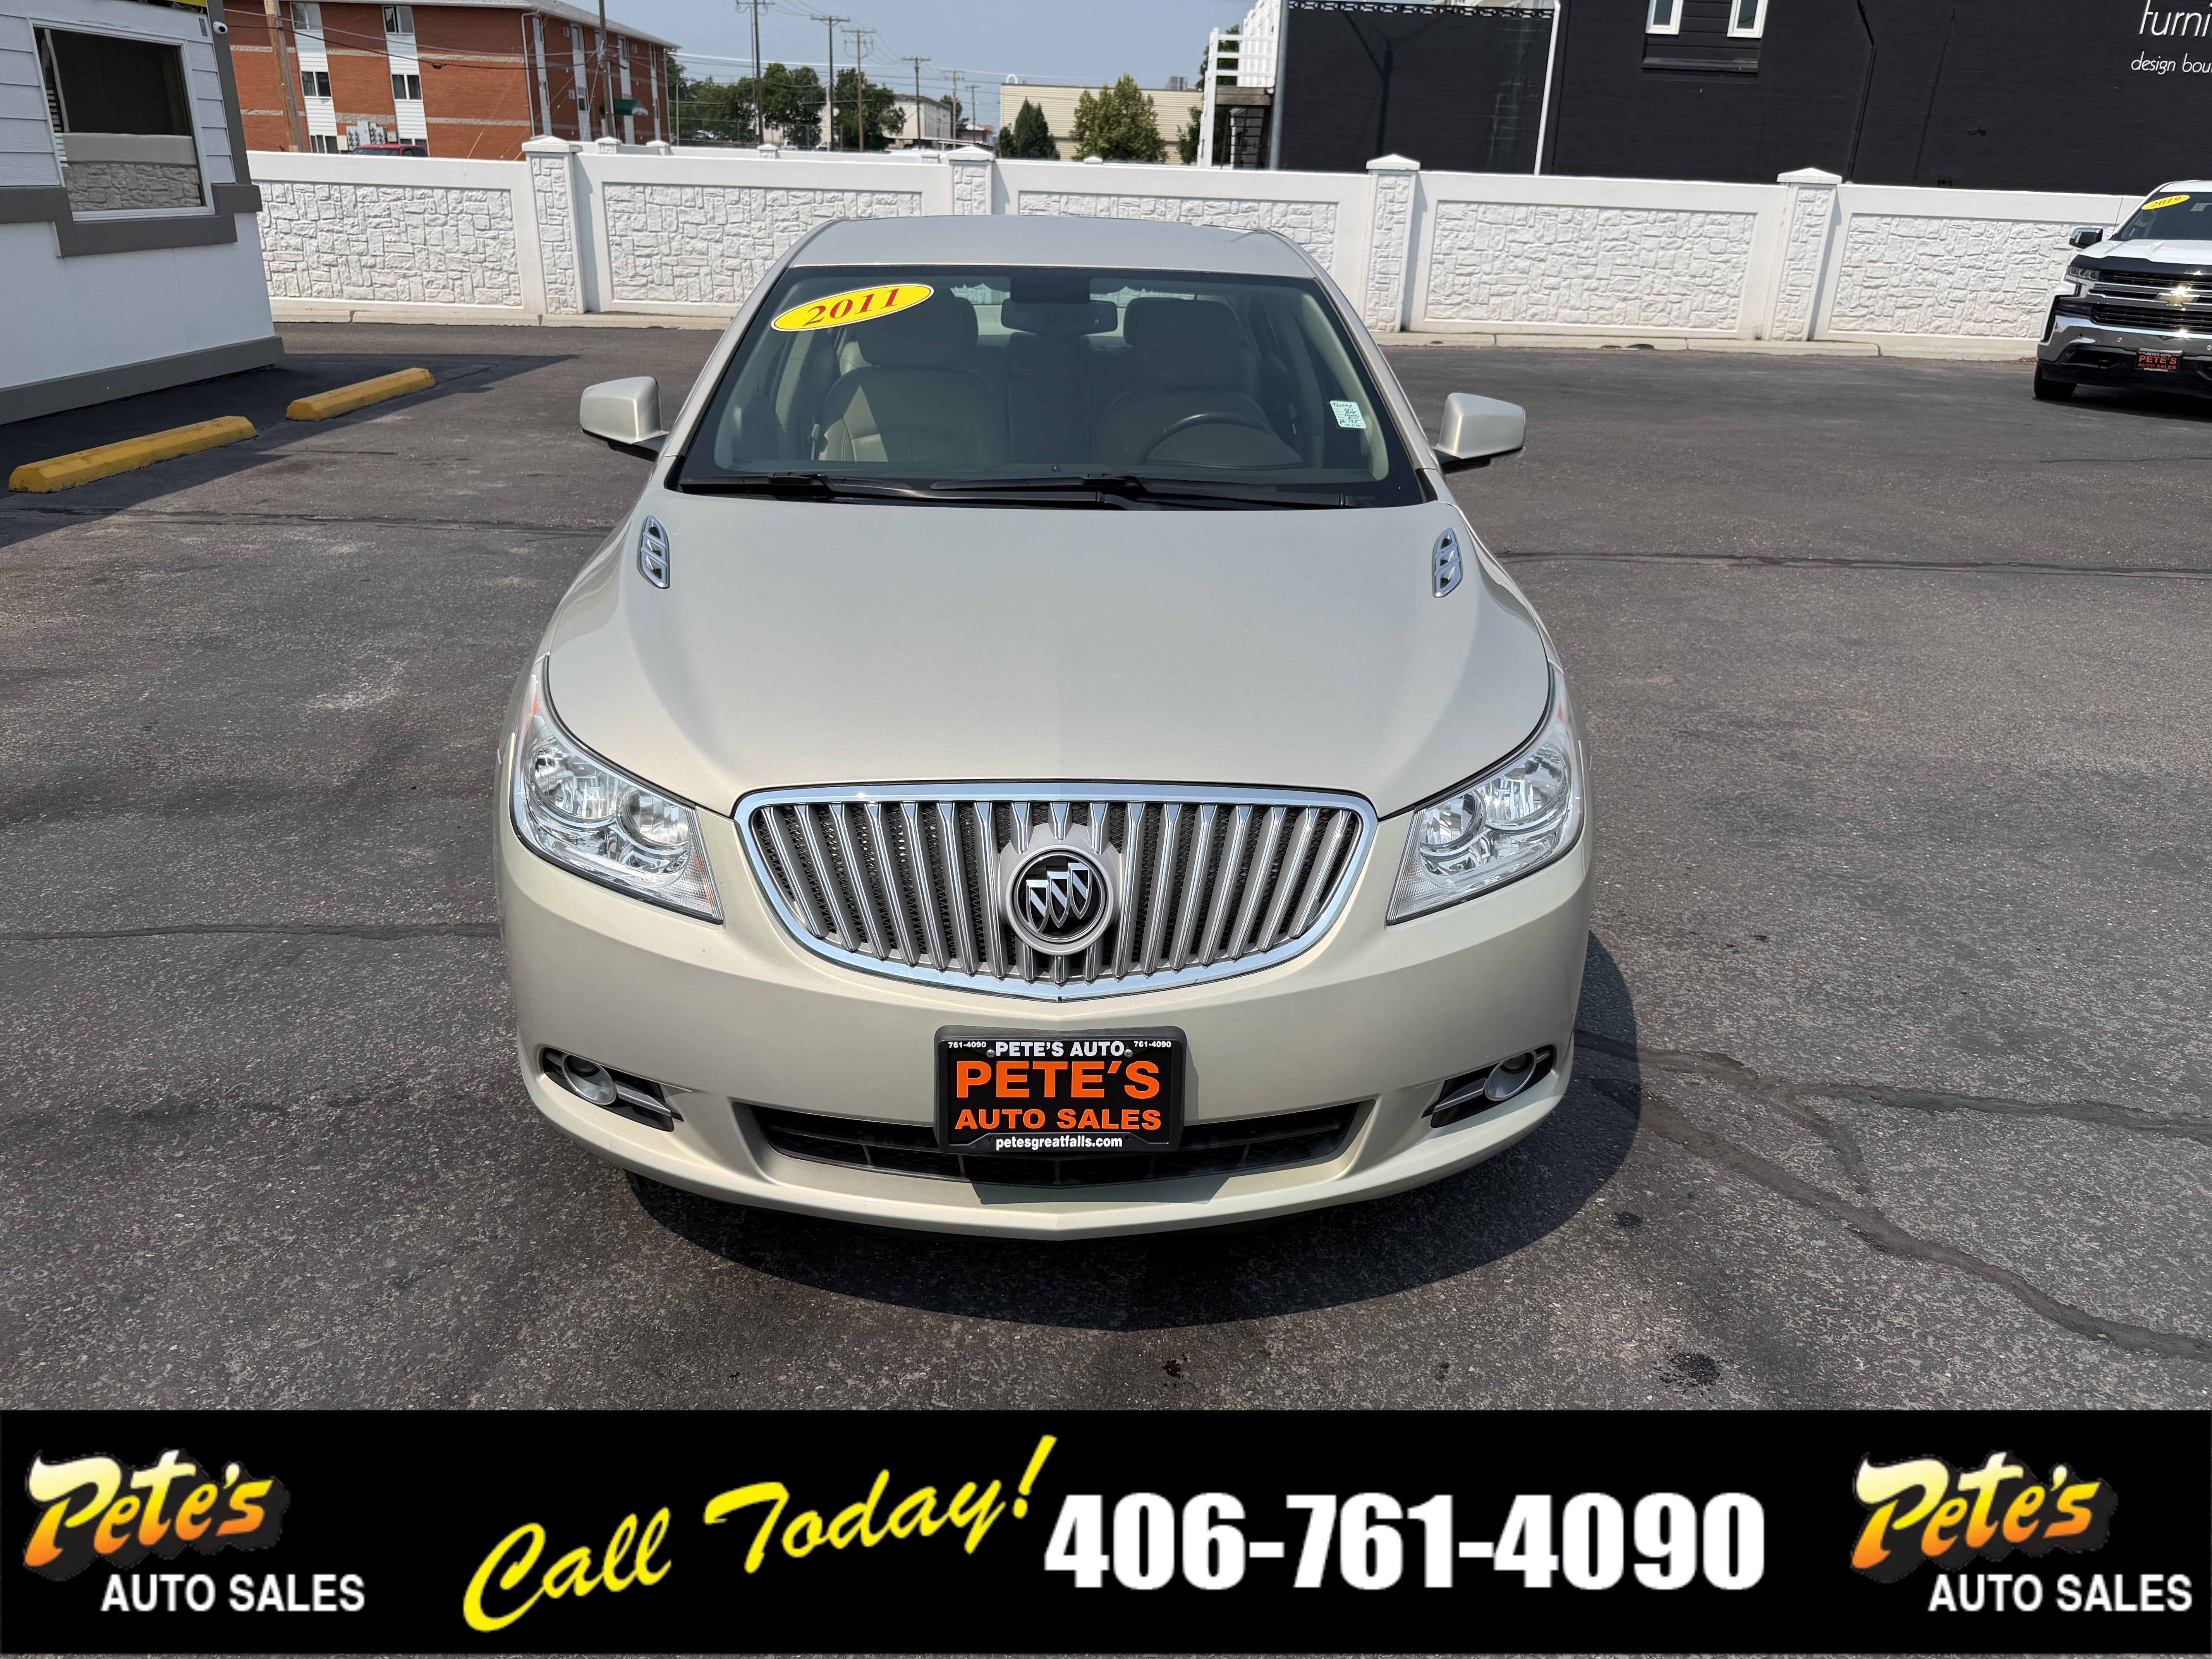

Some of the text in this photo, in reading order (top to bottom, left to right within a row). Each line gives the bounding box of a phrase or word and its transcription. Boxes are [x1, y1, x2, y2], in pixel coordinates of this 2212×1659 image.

[2131, 51, 2212, 75] design bou
[802, 288, 900, 327] 2011
[2138, 355, 2177, 364] PETE'S
[996, 1041, 1125, 1057] PETE'S AUTO
[957, 1060, 1160, 1099] PETE'S
[955, 1108, 1161, 1130] AUTO SALES
[996, 1135, 1123, 1151] petesgreatfalls.com
